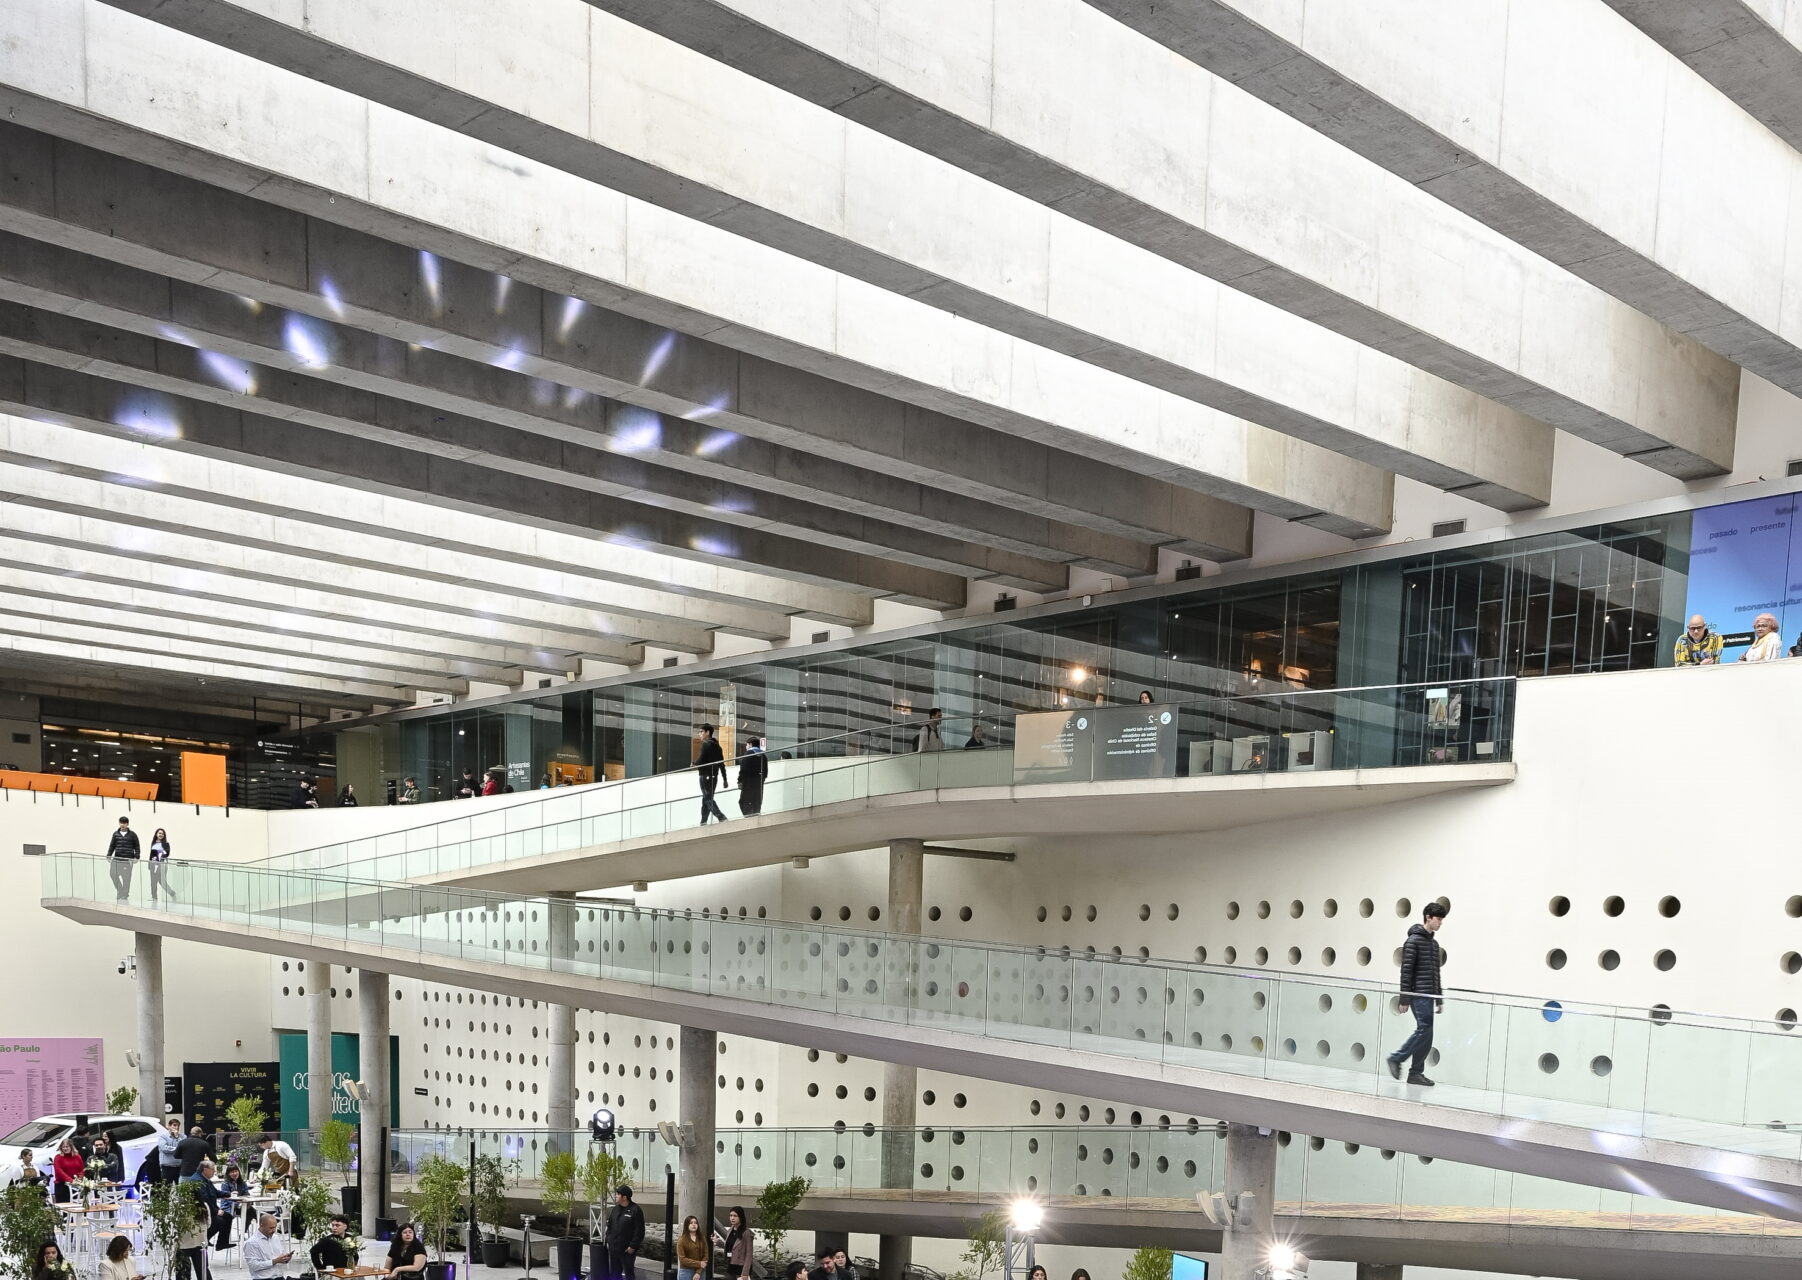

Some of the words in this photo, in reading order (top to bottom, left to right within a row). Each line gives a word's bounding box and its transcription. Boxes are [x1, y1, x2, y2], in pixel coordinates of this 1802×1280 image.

[1709, 528, 1738, 540] pasado
[1750, 521, 1786, 534] presente
[1734, 600, 1778, 613] resonancia
[14, 1045, 41, 1053] Paulo
